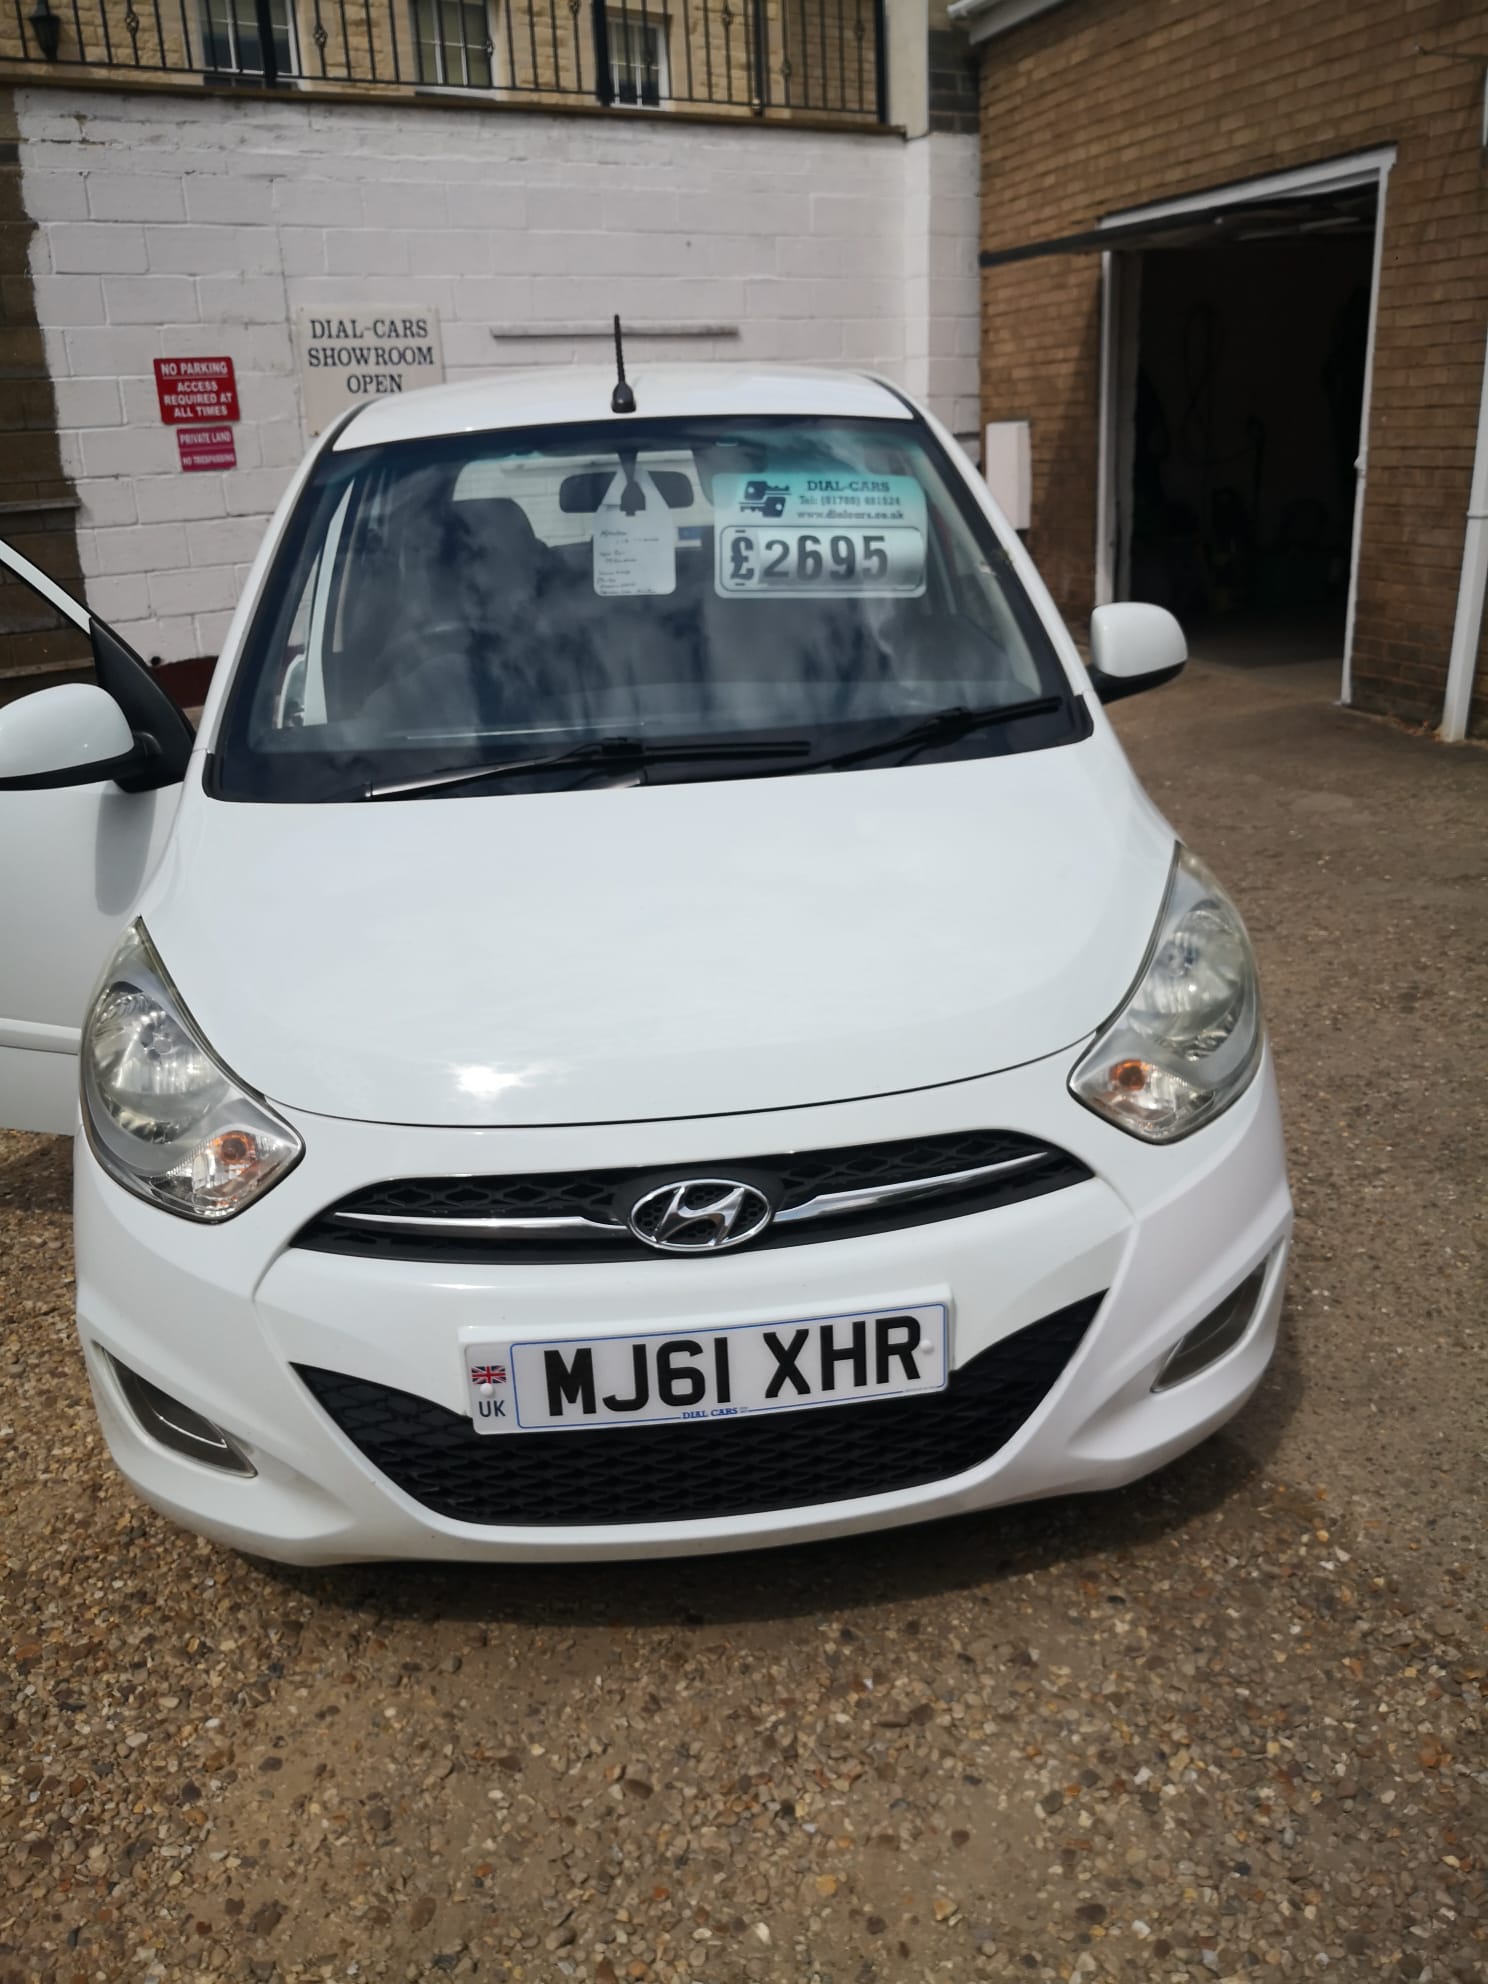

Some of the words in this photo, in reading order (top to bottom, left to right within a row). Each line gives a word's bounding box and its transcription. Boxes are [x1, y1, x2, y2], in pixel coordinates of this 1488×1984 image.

[310, 319, 428, 339] DIAL-CARS
[308, 346, 434, 367] SHOWROOM
[161, 363, 177, 375] NO
[180, 361, 227, 374] PARKING
[177, 381, 218, 392] ACCESS
[347, 374, 403, 394] OPEN
[164, 393, 217, 405] REQUIRED
[220, 392, 233, 403] AT
[174, 406, 193, 418] ALL
[196, 404, 228, 416] TIMES
[180, 432, 210, 445] PRIVATE
[211, 430, 231, 443] LAND
[183, 456, 192, 466] NO
[807, 480, 890, 492] DIAL-CARS
[730, 534, 888, 581] £2695
[543, 1336, 732, 1417] MJ61
[763, 1314, 922, 1399] XHR
[478, 1400, 506, 1418] UK
[682, 1410, 708, 1419] DIAL
[711, 1407, 738, 1417] CARS
